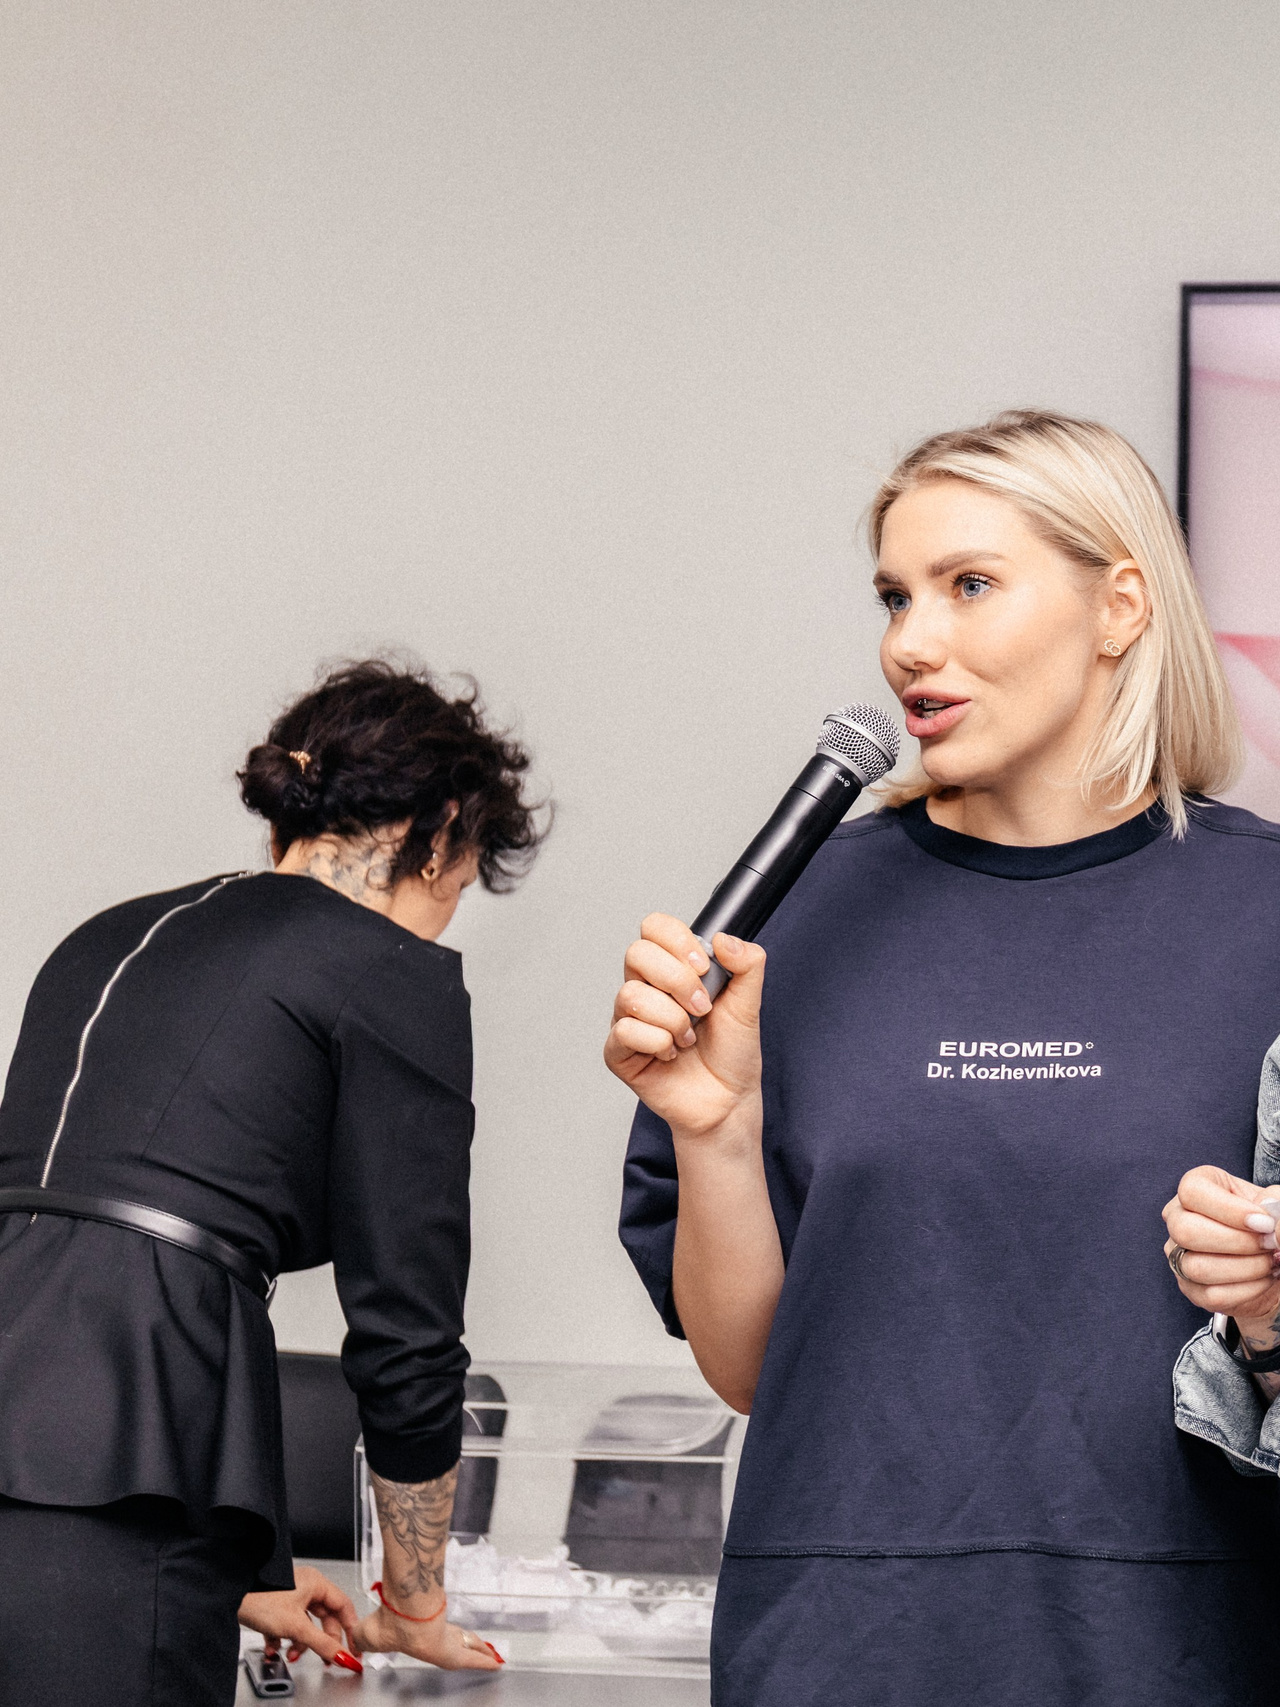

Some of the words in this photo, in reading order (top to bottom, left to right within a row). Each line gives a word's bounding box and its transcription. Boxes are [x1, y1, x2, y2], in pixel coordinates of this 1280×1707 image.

[939, 1041, 1084, 1058] EUROMED
[927, 1062, 955, 1079] Dr.
[961, 1063, 1102, 1080] Kozhevnikova
